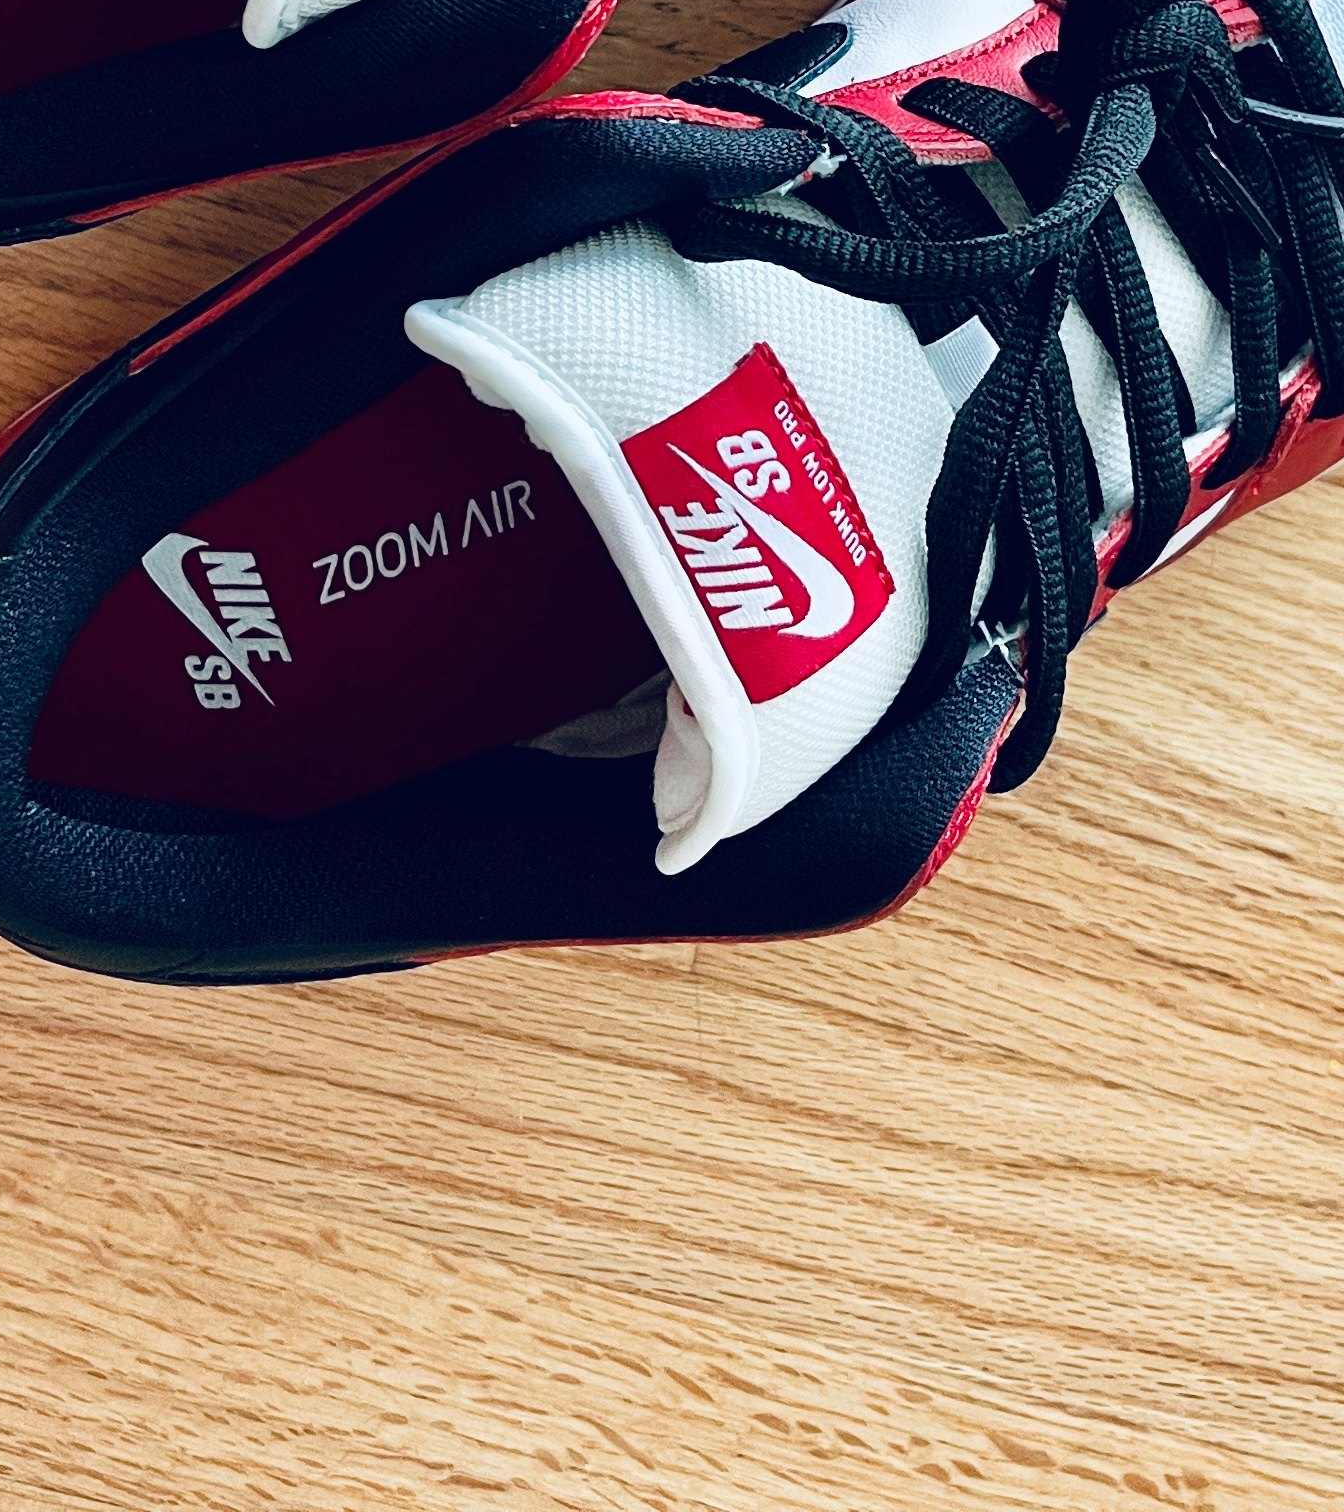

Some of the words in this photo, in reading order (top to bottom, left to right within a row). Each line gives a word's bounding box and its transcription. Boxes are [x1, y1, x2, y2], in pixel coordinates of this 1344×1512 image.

[774, 399, 807, 451] PRO
[716, 429, 791, 500] SB
[801, 451, 836, 505] LOW
[312, 512, 449, 605] ZOOM
[461, 479, 536, 549] AIR
[659, 497, 794, 630] NIKE
[829, 500, 866, 567] DUNK
[199, 551, 292, 663] NIKE
[184, 654, 242, 710] SB
